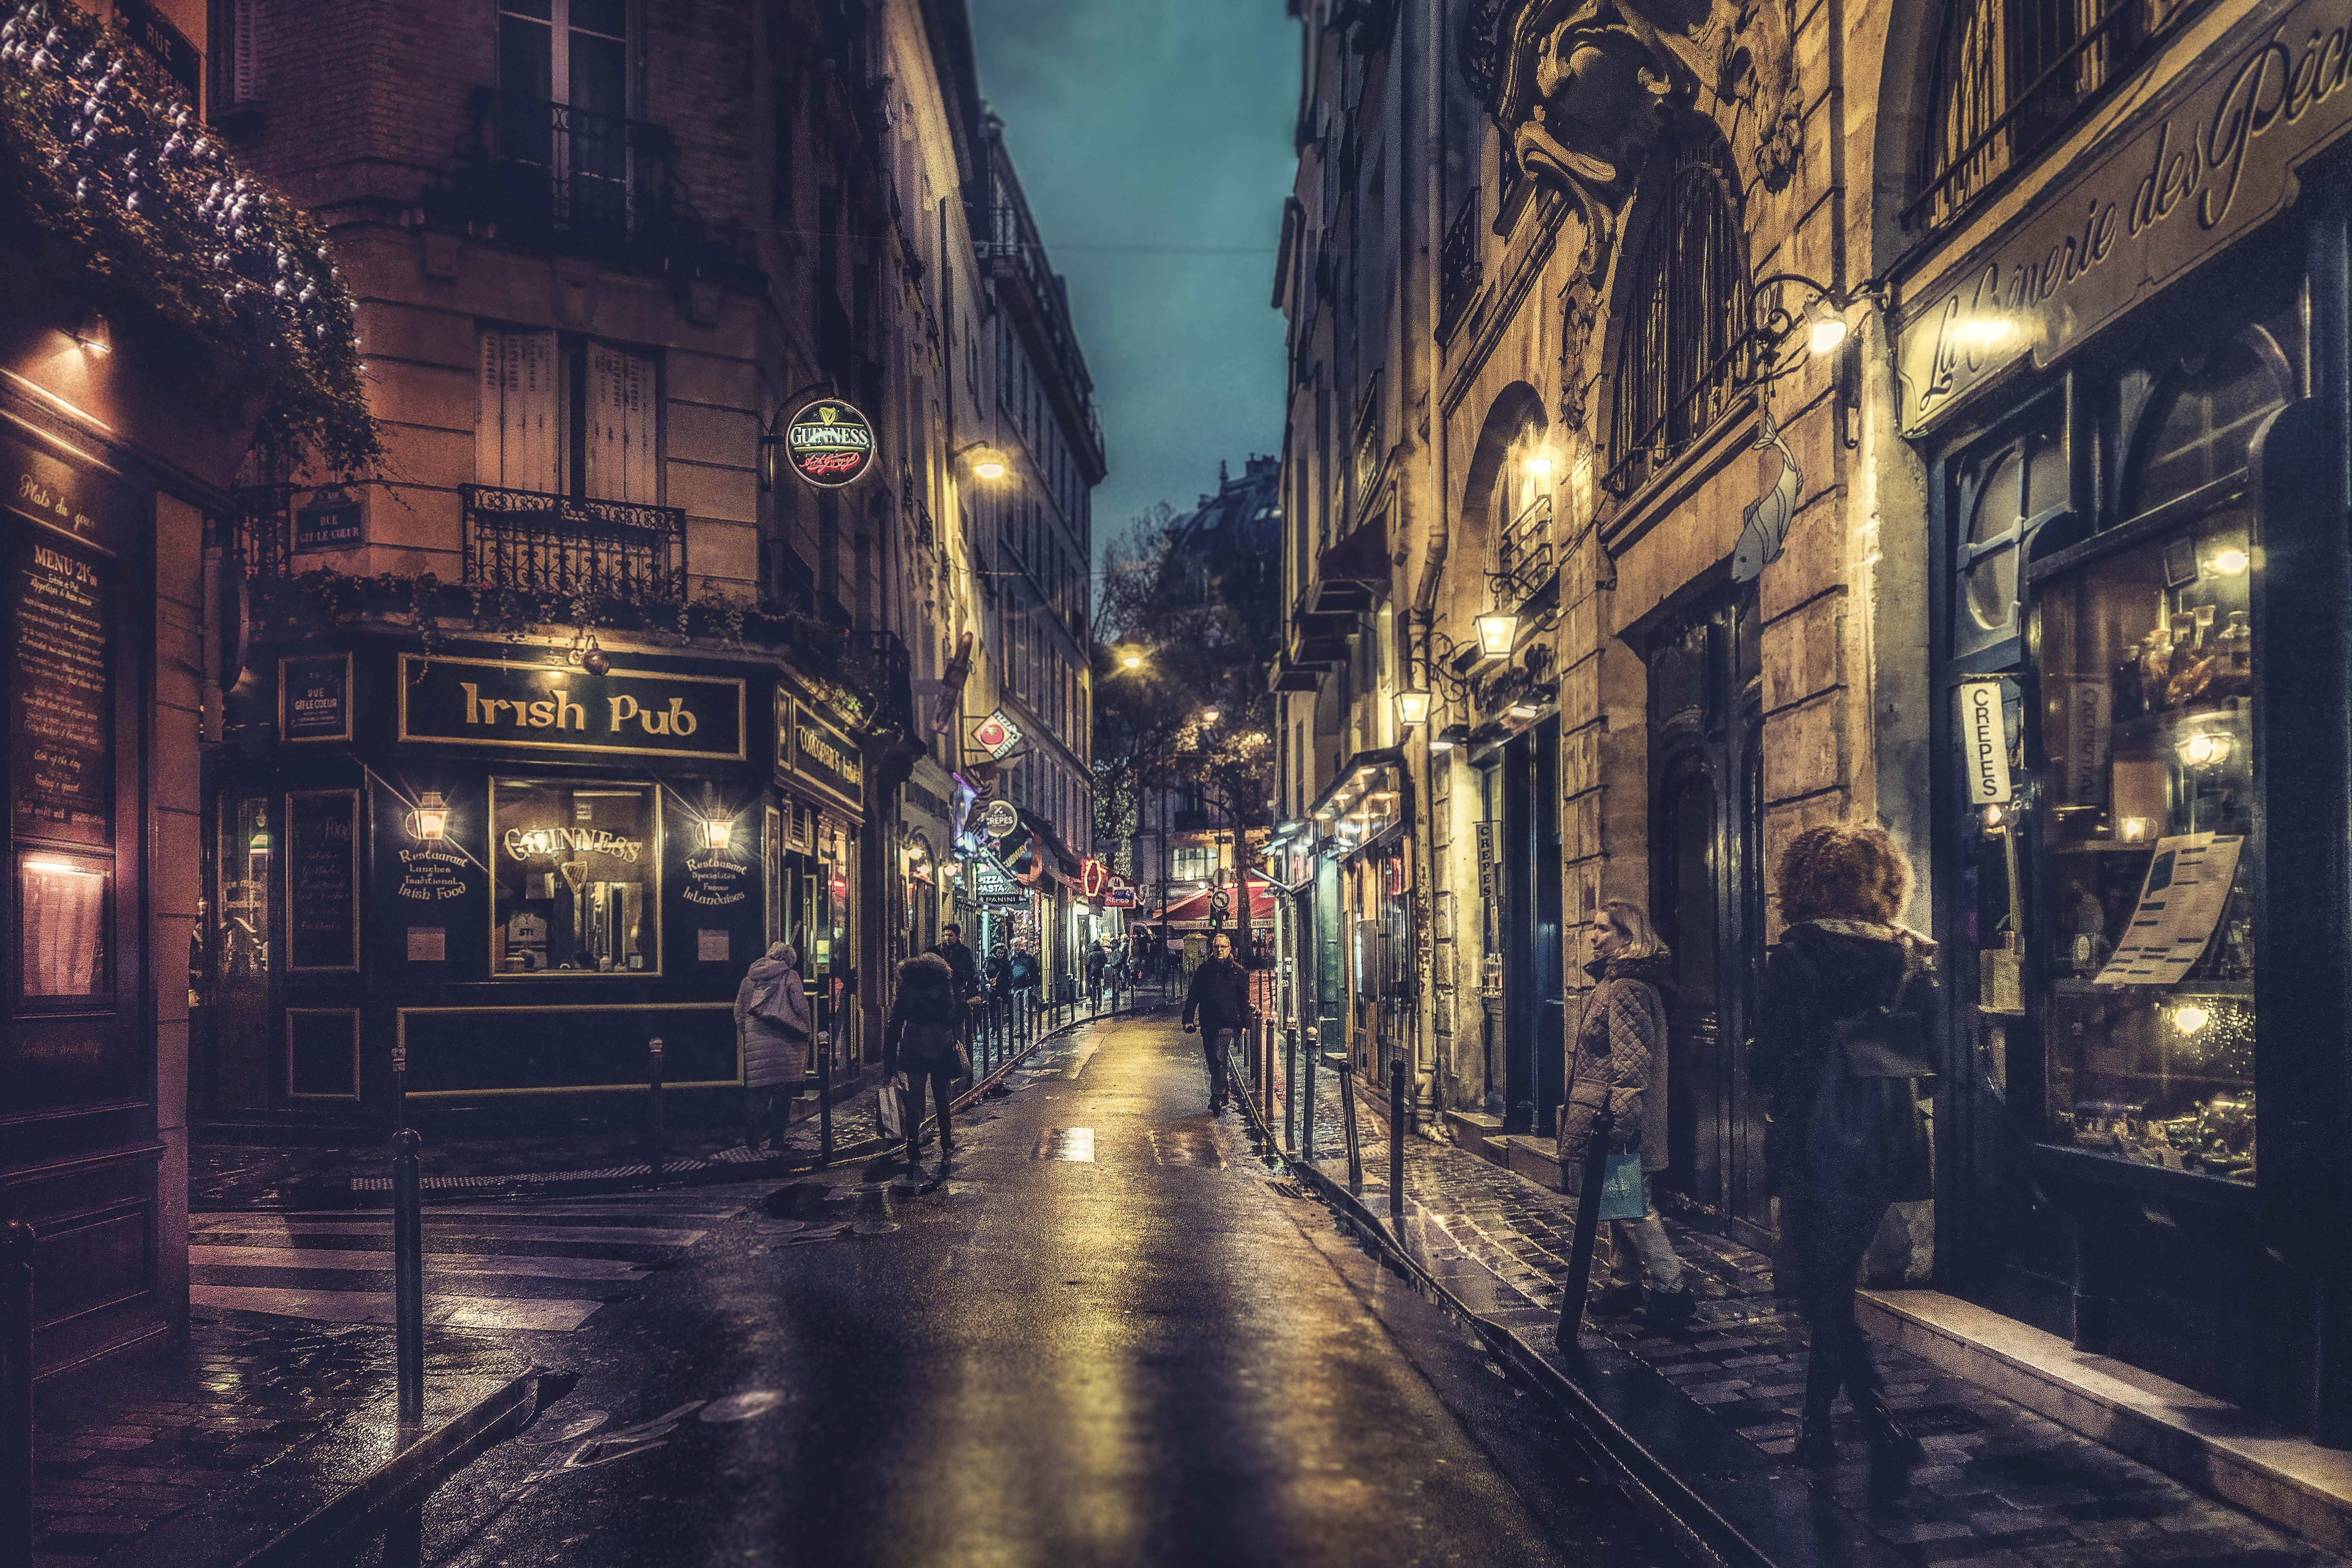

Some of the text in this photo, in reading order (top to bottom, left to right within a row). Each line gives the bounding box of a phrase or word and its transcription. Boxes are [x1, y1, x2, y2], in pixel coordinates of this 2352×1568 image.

[147, 22, 171, 60] RUE
[2129, 120, 2204, 239] des
[789, 426, 869, 446] GUINNESS
[20, 474, 50, 507] Plats
[55, 497, 69, 517] du
[320, 515, 338, 526] RUE
[34, 544, 73, 576] MENU
[307, 688, 325, 697] RUE
[460, 682, 697, 736] Irish Pub
[994, 711, 1018, 734] PIZZA
[993, 731, 1023, 760] RUSTICA
[1973, 689, 1997, 796] CREPES
[986, 816, 1013, 825] CREPES
[398, 849, 468, 867] Restaurant
[409, 863, 451, 873] Lunches
[686, 858, 747, 875] Restaurant
[1480, 826, 1491, 897] CREPES
[977, 875, 1004, 884] PIZZA
[436, 882, 466, 900] Food
